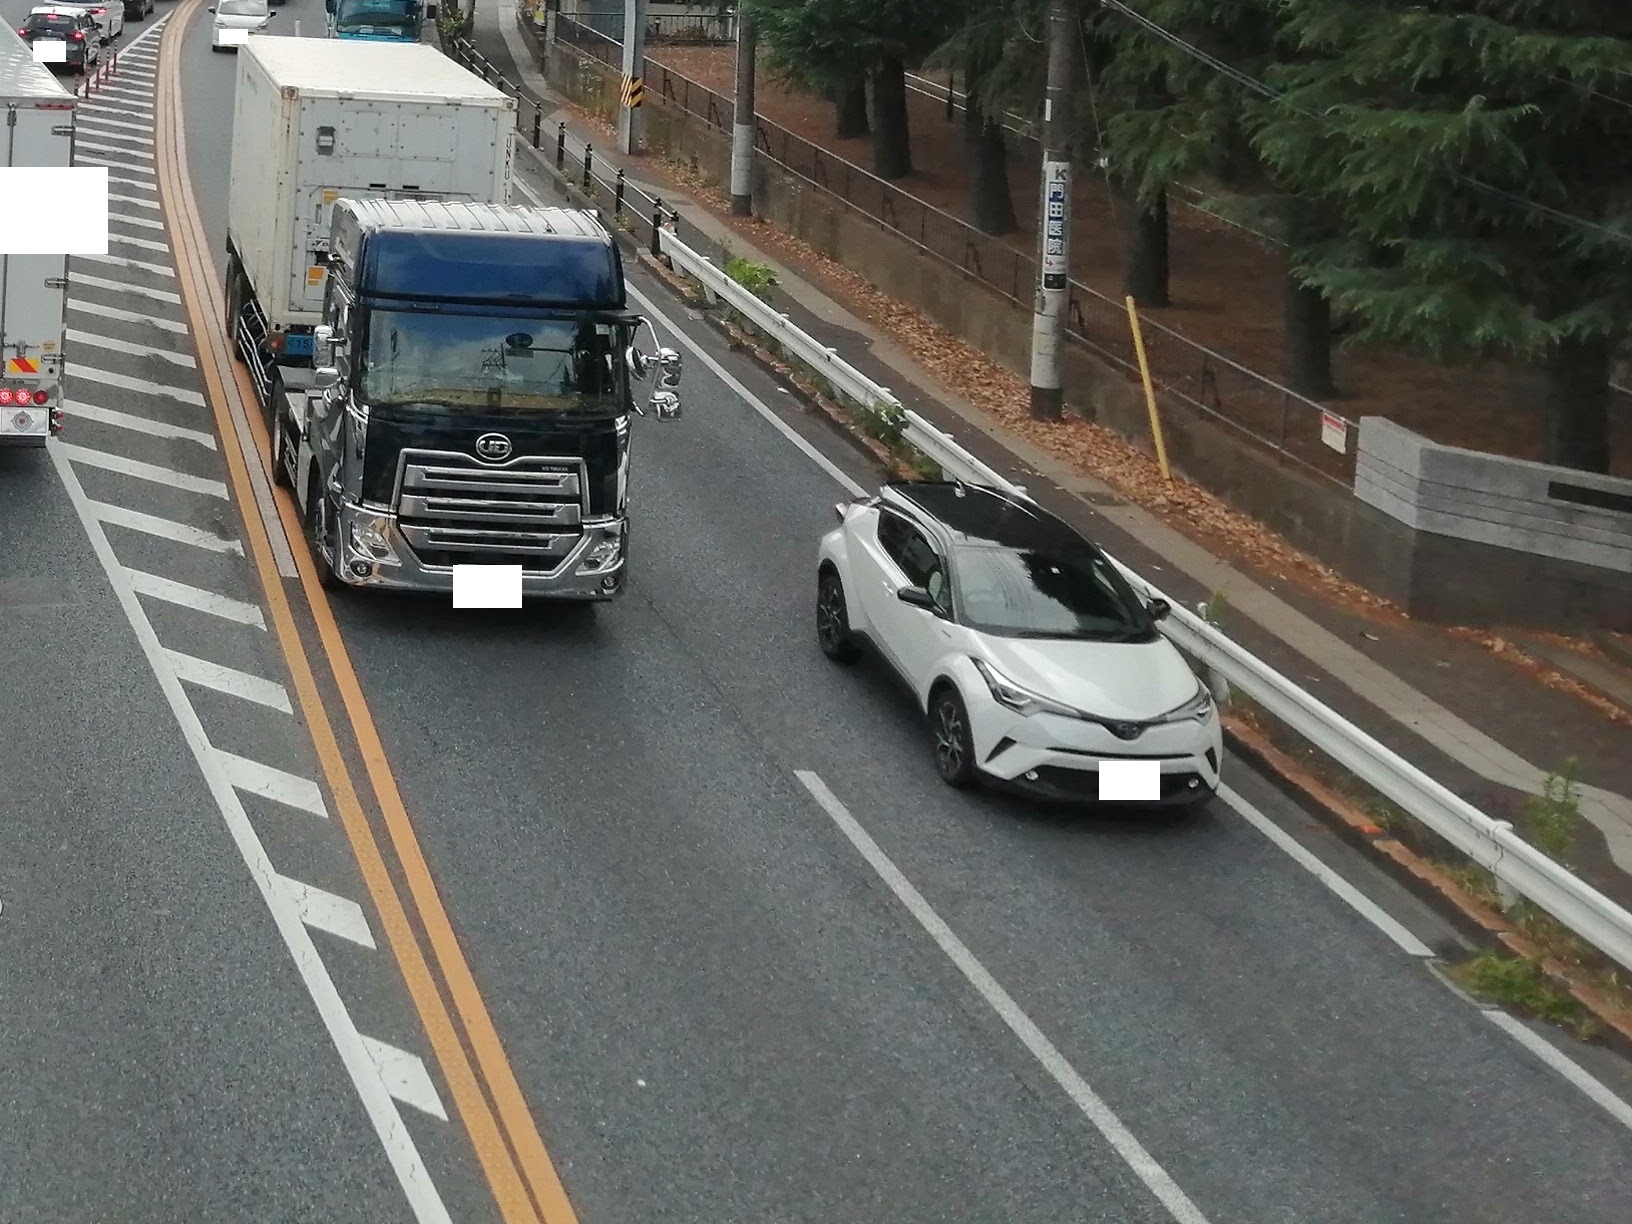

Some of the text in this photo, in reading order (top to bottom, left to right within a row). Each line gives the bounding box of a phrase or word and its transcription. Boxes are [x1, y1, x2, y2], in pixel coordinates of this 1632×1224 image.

[1055, 168, 1067, 181] K
[1047, 182, 1065, 255] 門田医院
